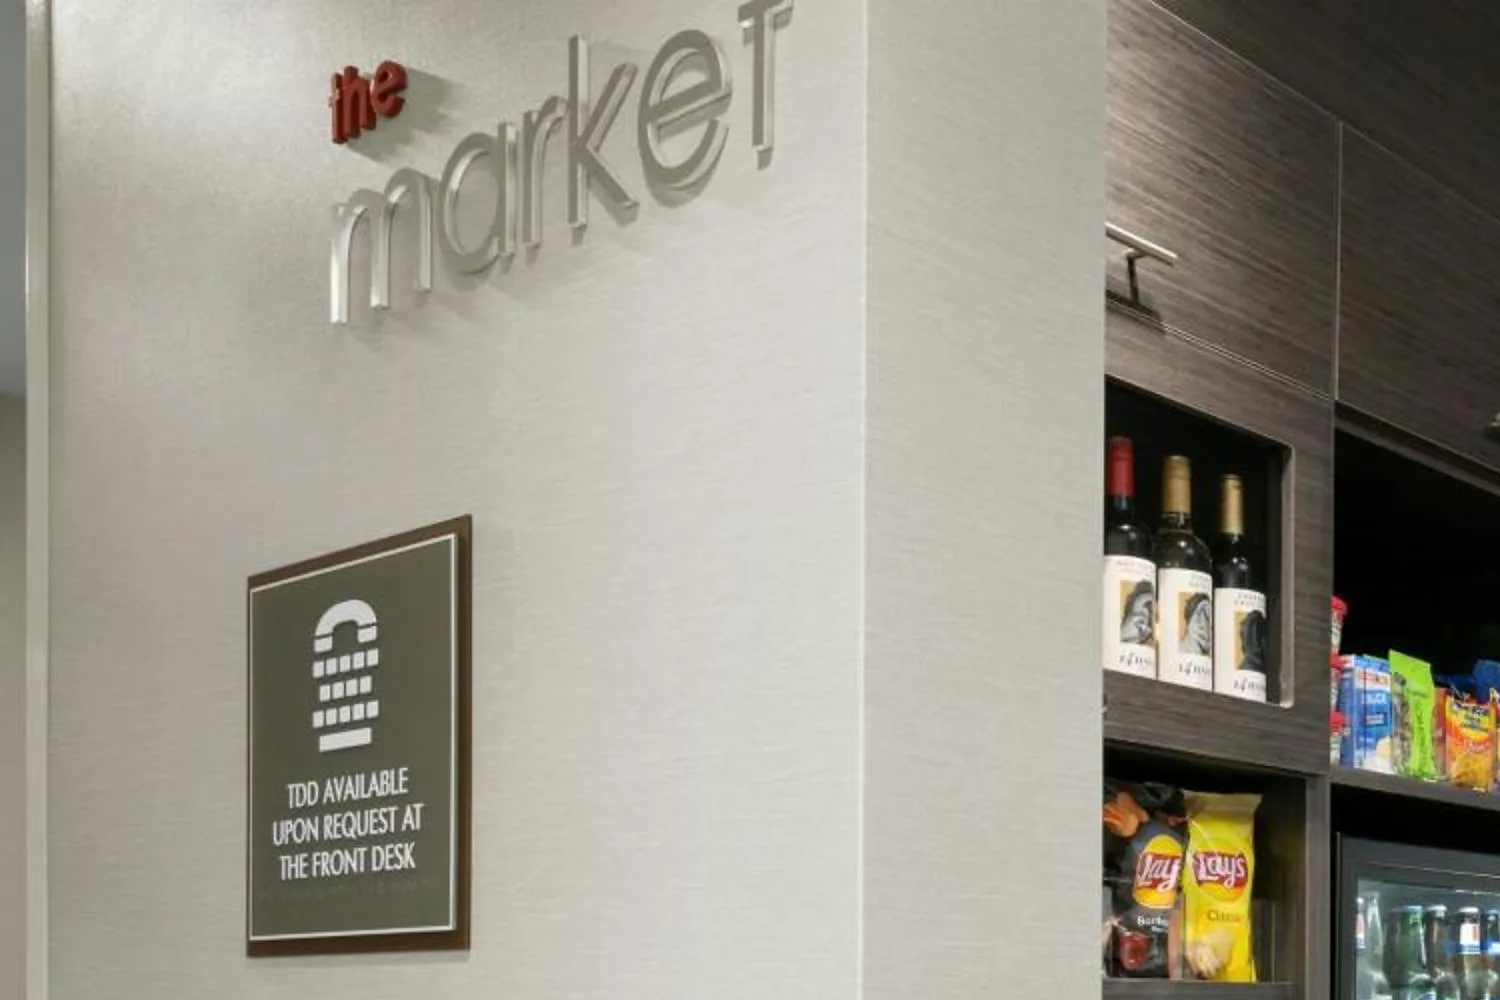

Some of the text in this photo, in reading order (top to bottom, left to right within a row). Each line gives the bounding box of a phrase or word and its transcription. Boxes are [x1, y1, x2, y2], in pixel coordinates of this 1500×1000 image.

[329, 60, 408, 145] the
[329, 0, 794, 324] market
[287, 766, 409, 809] TDD AVAILABLE
[272, 802, 426, 847] UPON REQUEST AT
[279, 841, 417, 881] THE FRONT DESK
[1193, 851, 1247, 889] Lay's
